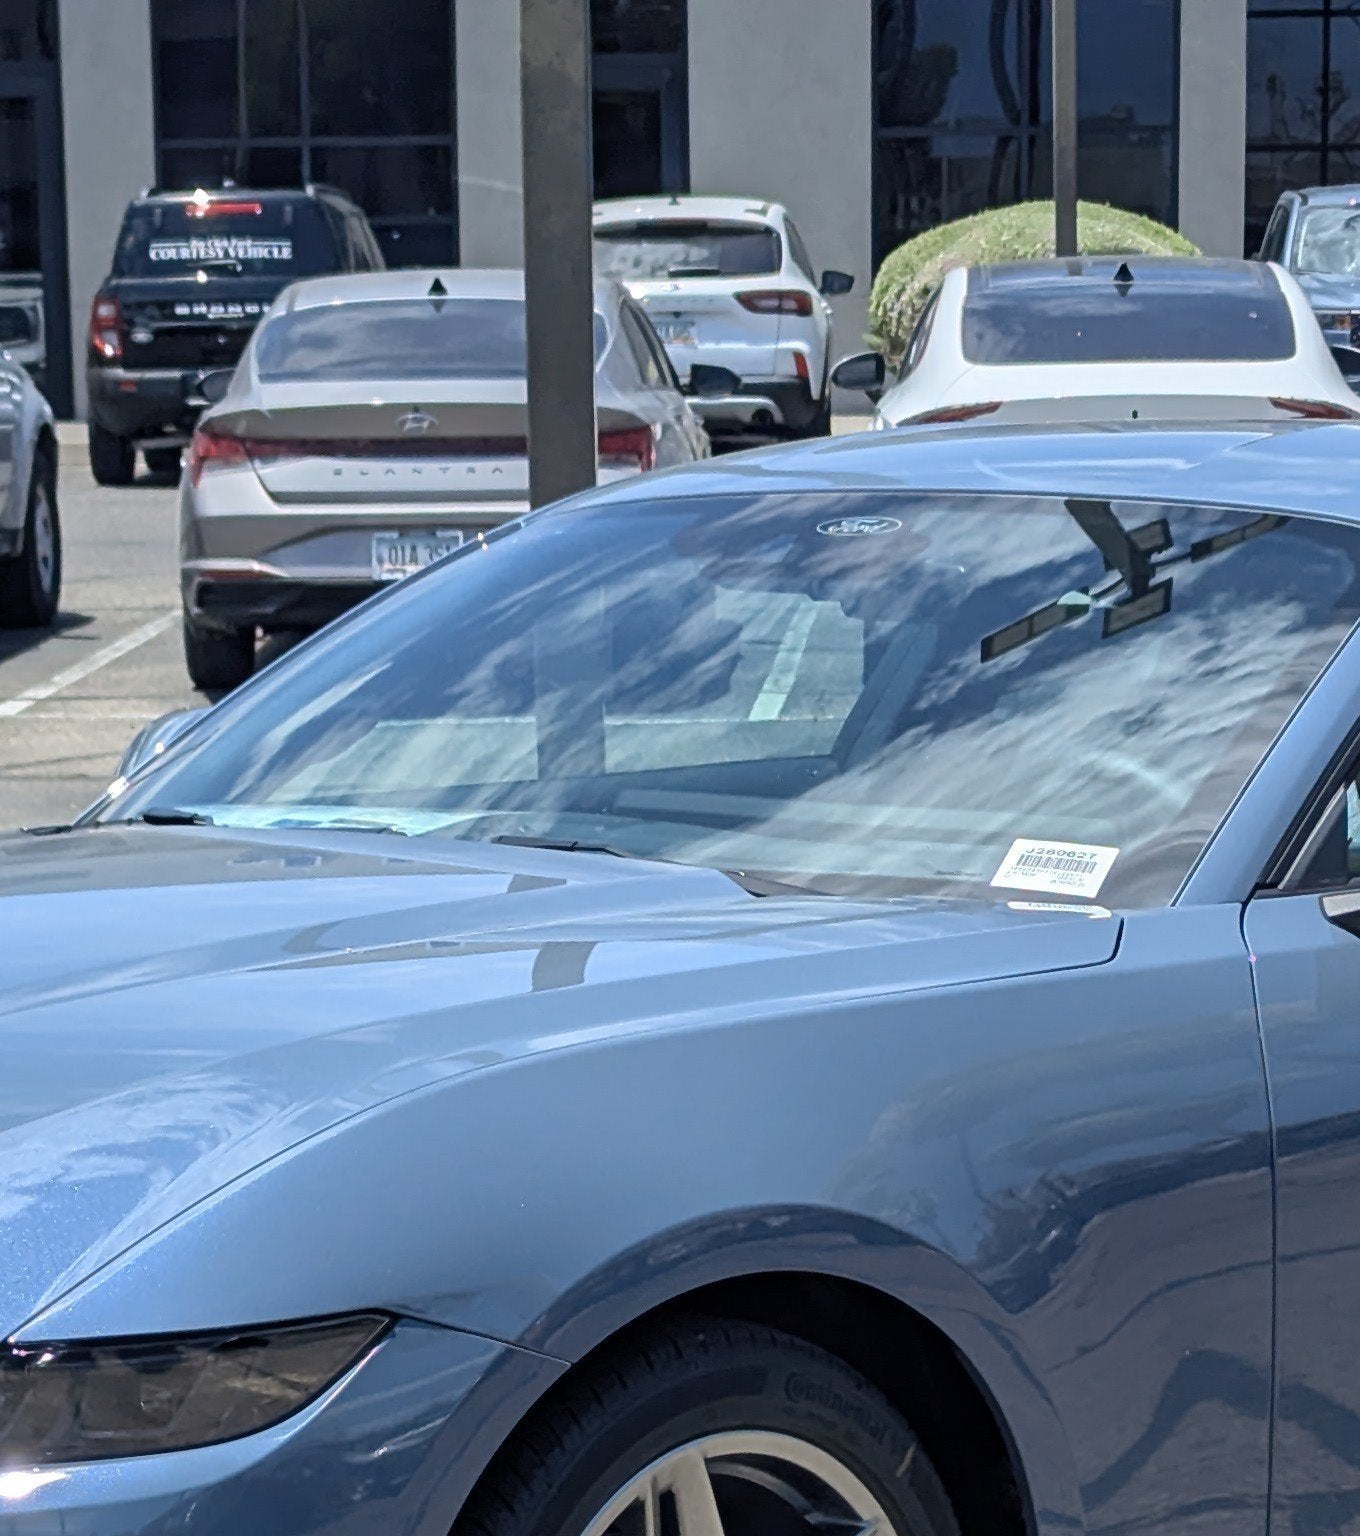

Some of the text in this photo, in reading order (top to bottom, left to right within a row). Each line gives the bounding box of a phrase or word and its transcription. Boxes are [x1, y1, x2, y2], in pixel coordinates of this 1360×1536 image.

[149, 245, 292, 260] COURTESY VEHICLE
[333, 466, 503, 476] ELANTRA
